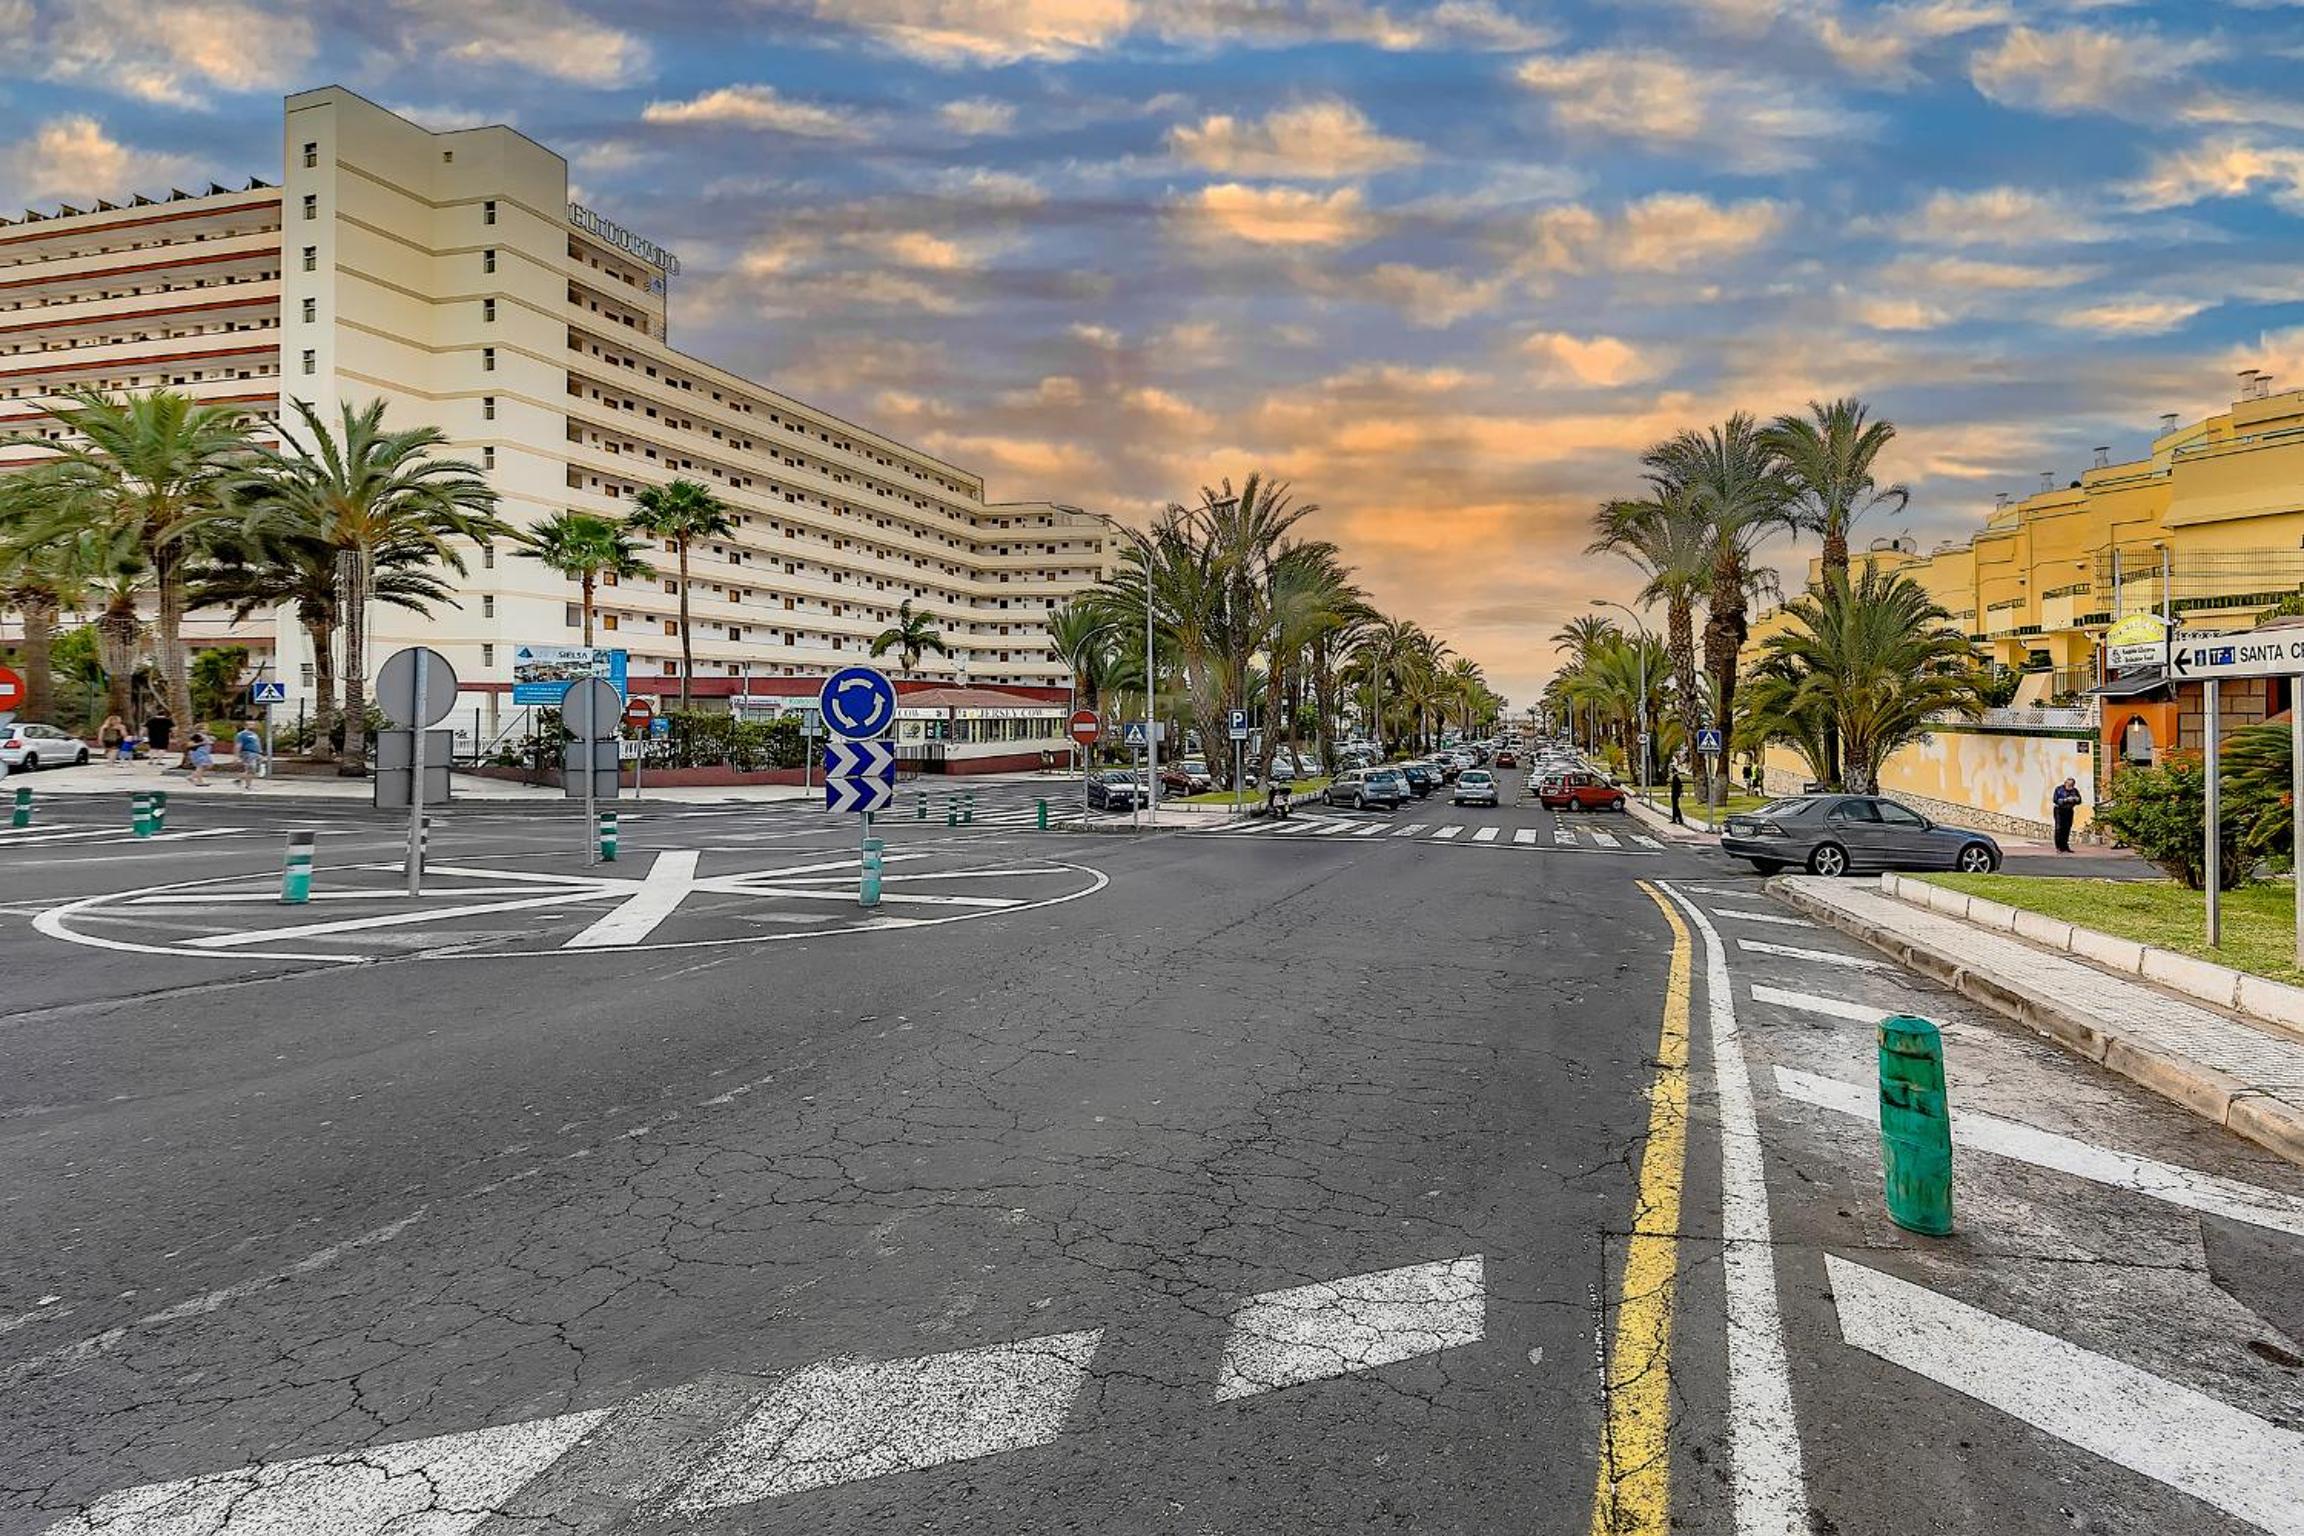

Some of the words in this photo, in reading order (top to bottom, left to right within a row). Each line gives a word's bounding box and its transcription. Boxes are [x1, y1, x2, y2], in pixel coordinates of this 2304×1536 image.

[2211, 648, 2235, 664] TF-1
[2240, 644, 2284, 663] SANTA
[1232, 712, 1243, 727] P
